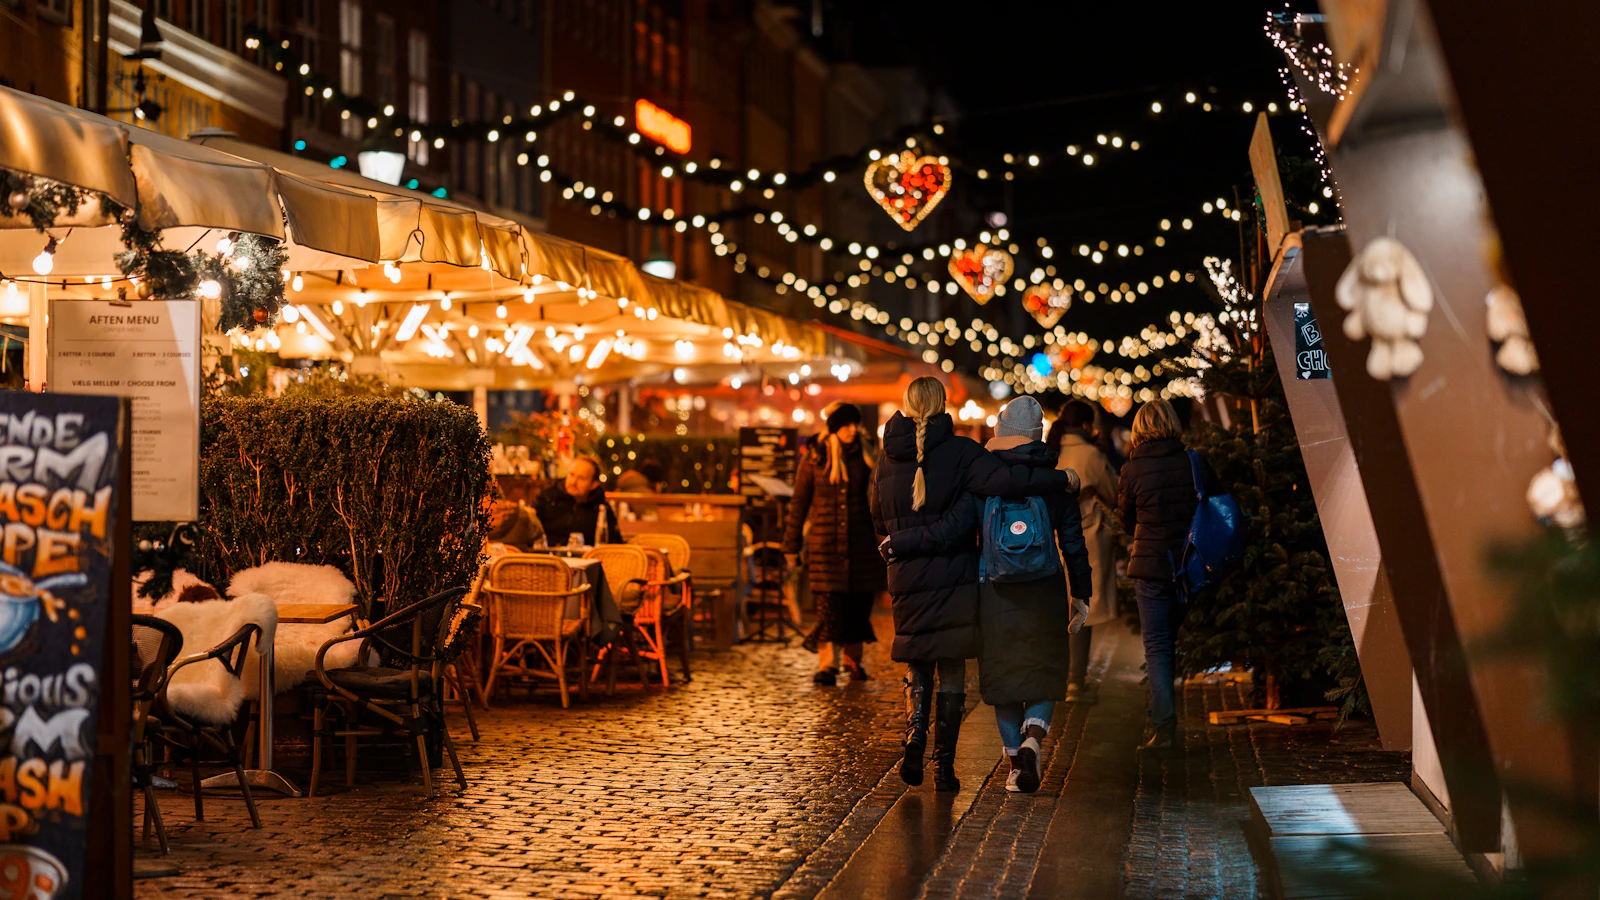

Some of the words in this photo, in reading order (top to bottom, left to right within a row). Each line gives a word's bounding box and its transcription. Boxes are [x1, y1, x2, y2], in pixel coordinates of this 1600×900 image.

[89, 315, 123, 325] AFTEN
[126, 315, 159, 325] MENU
[0, 522, 81, 579] PE
